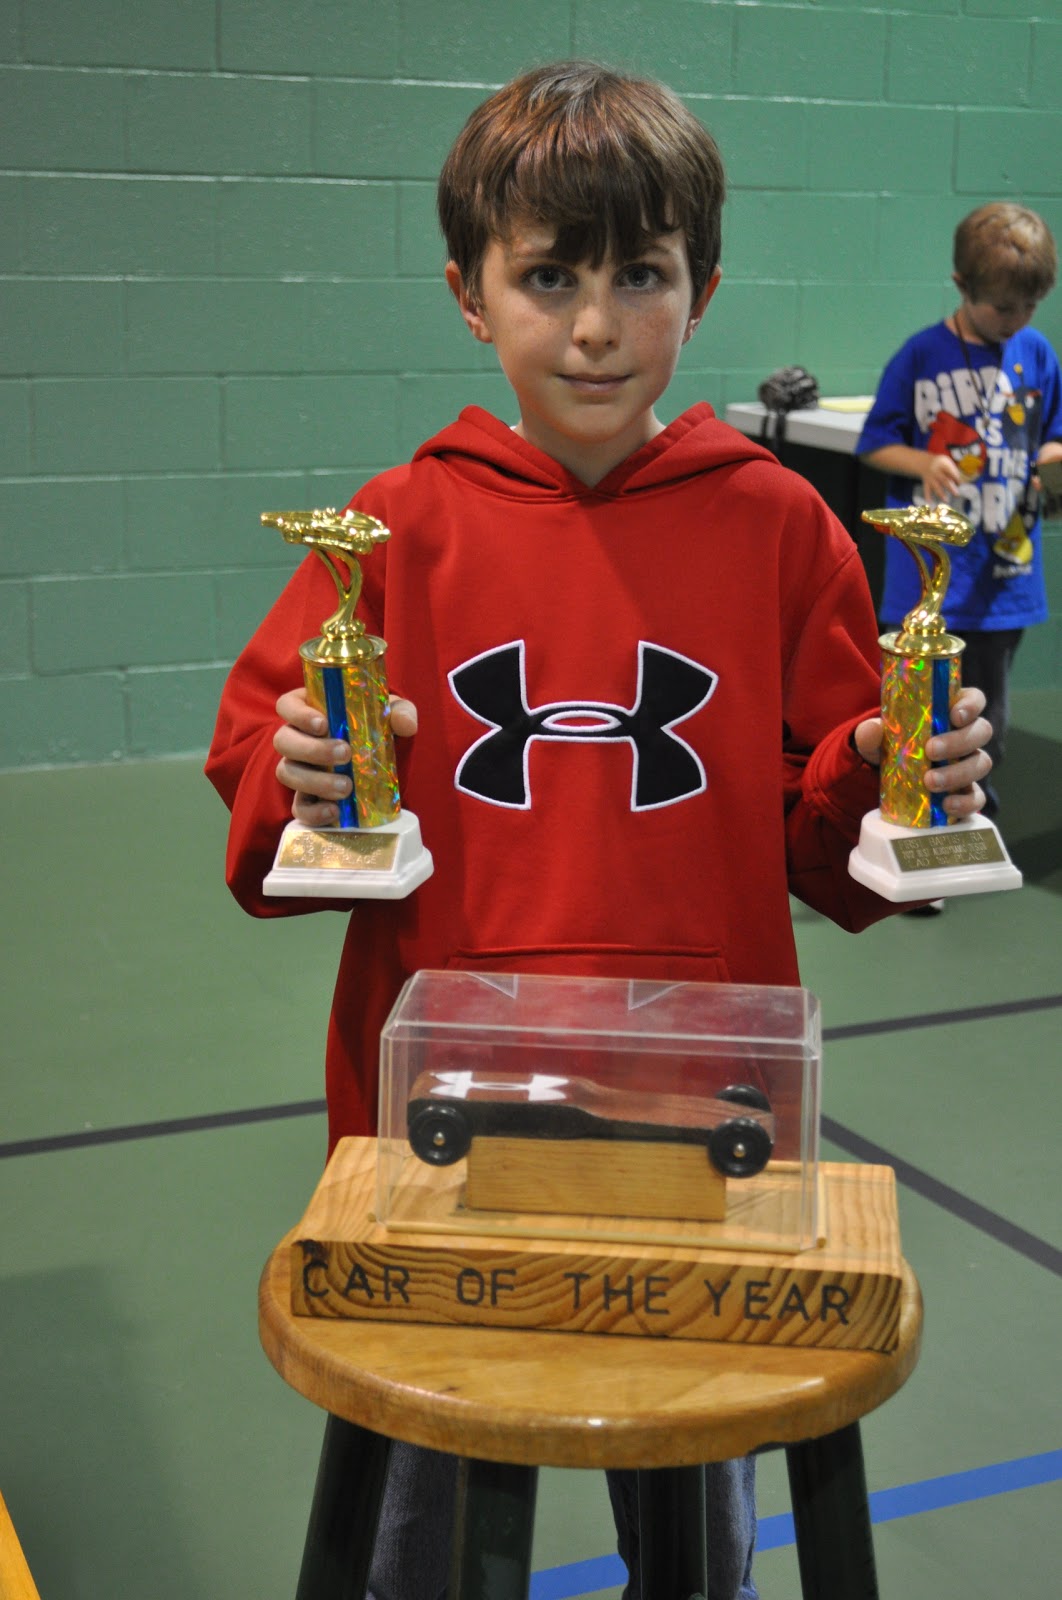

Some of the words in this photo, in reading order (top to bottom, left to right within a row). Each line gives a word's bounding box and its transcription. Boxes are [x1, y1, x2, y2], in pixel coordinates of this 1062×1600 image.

[986, 447, 1028, 478] THE
[301, 1260, 411, 1303] CAR
[456, 1268, 516, 1307] OF
[563, 1272, 670, 1315] THE
[703, 1278, 850, 1325] YEAR
